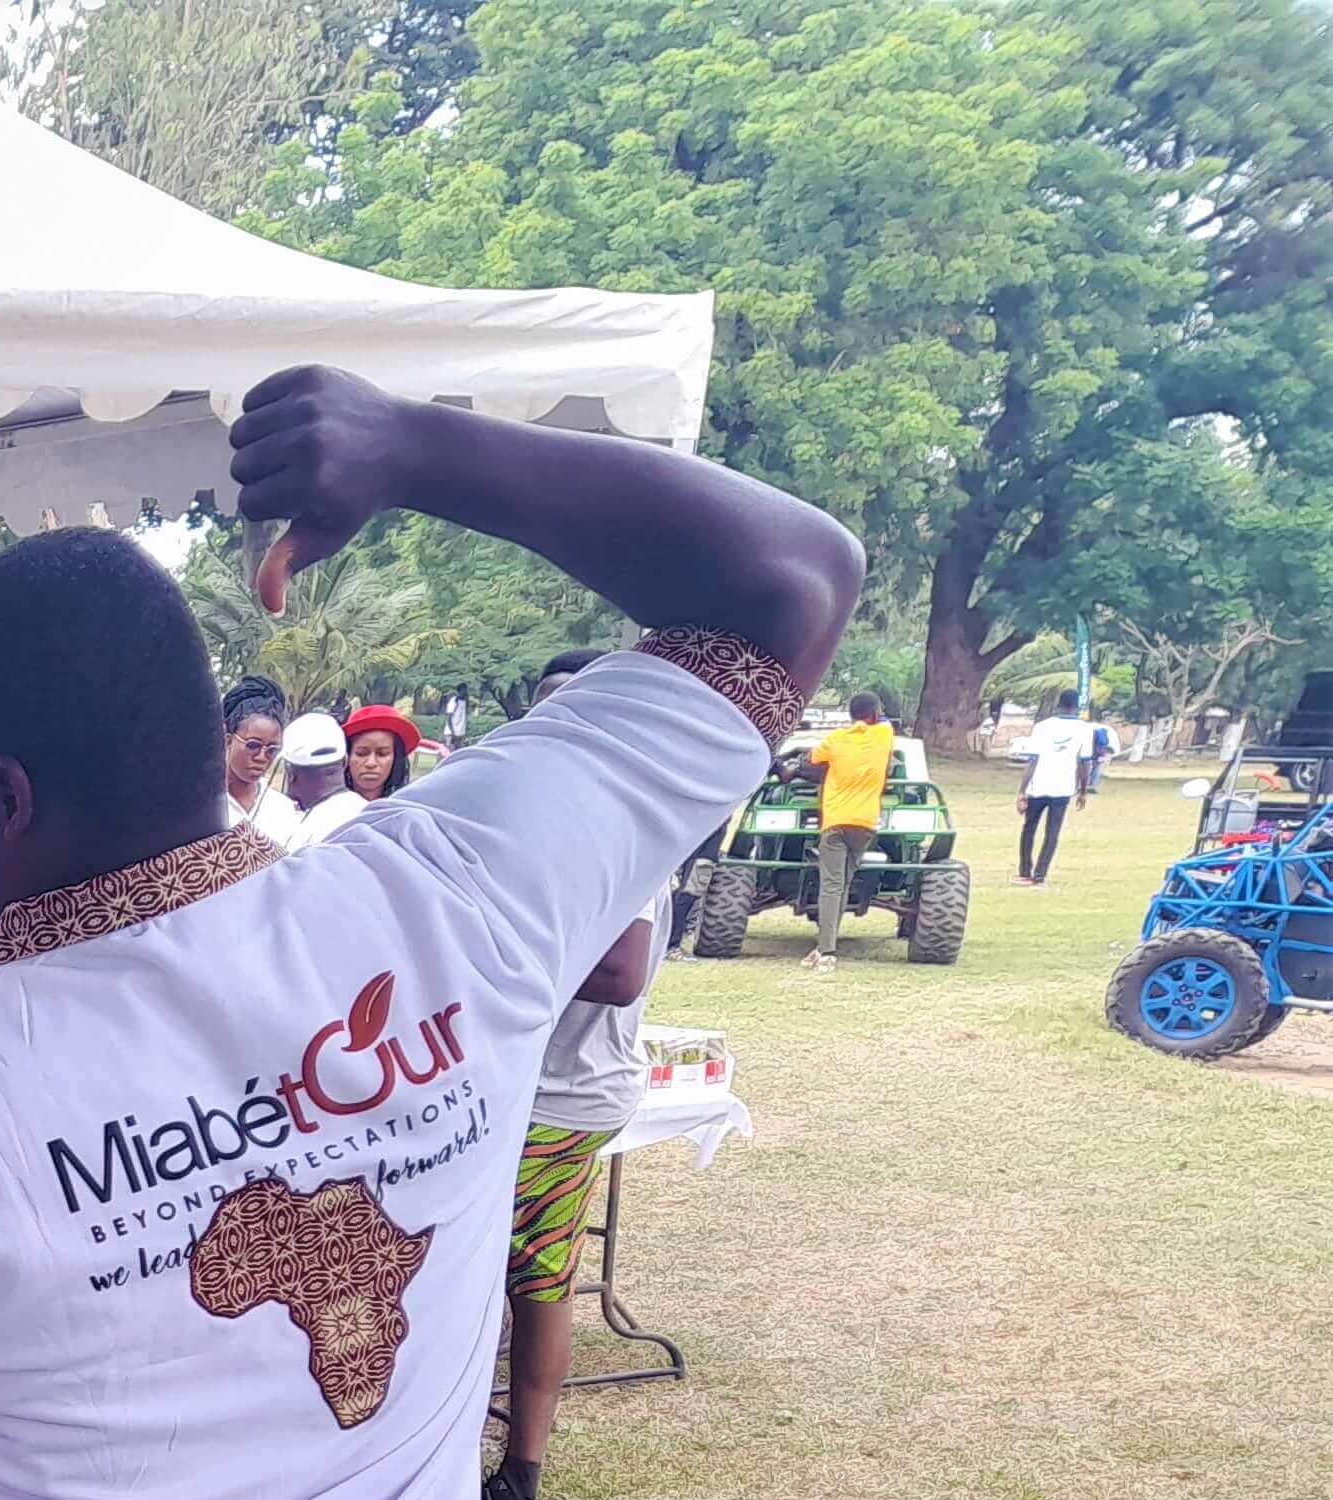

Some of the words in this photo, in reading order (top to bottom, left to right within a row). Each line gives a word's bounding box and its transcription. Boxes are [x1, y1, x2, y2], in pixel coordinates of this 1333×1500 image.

[89, 1266, 130, 1291] we
[139, 1223, 197, 1279] lead
[374, 1098, 490, 1200] forward!
[91, 1185, 227, 1243] BEYOND
[244, 1080, 474, 1184] EXPECTATIONS
